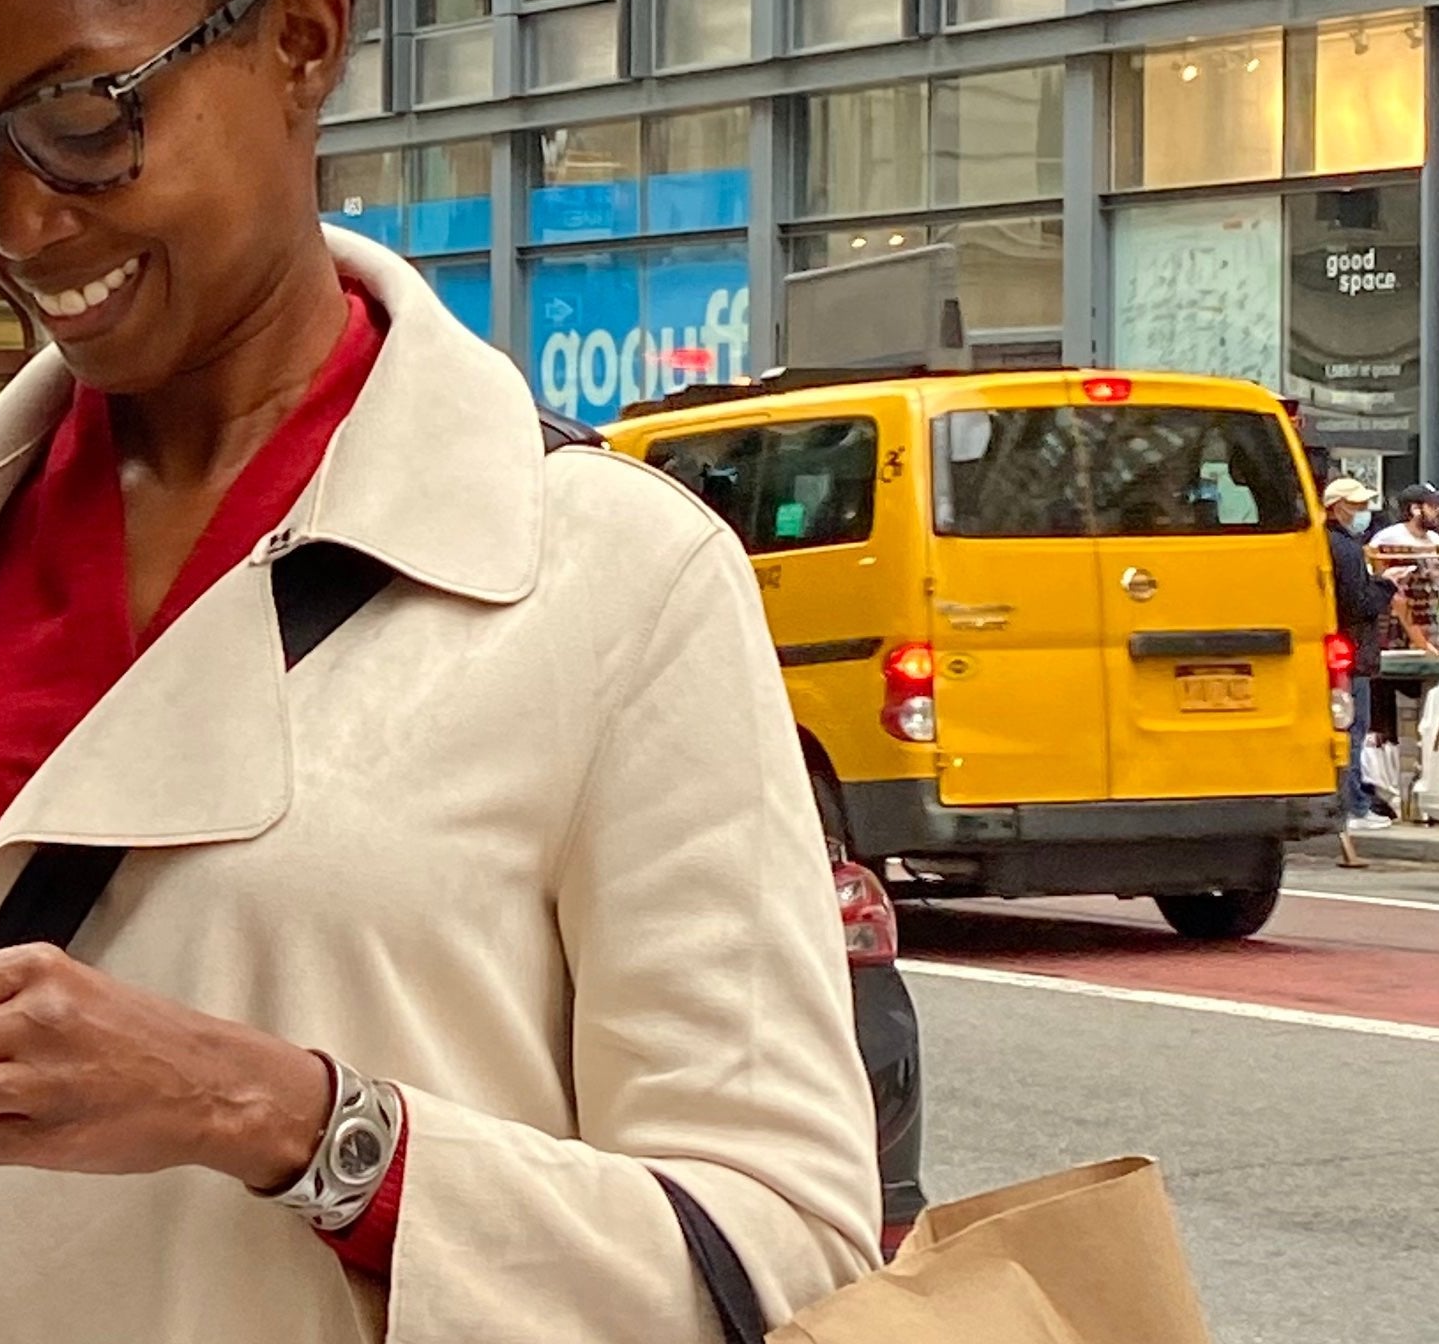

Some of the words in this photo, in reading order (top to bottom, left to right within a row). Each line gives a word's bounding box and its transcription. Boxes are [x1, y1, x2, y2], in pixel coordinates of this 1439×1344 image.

[1326, 248, 1375, 277] good
[1338, 271, 1396, 296] space
[540, 288, 750, 419] gopuff
